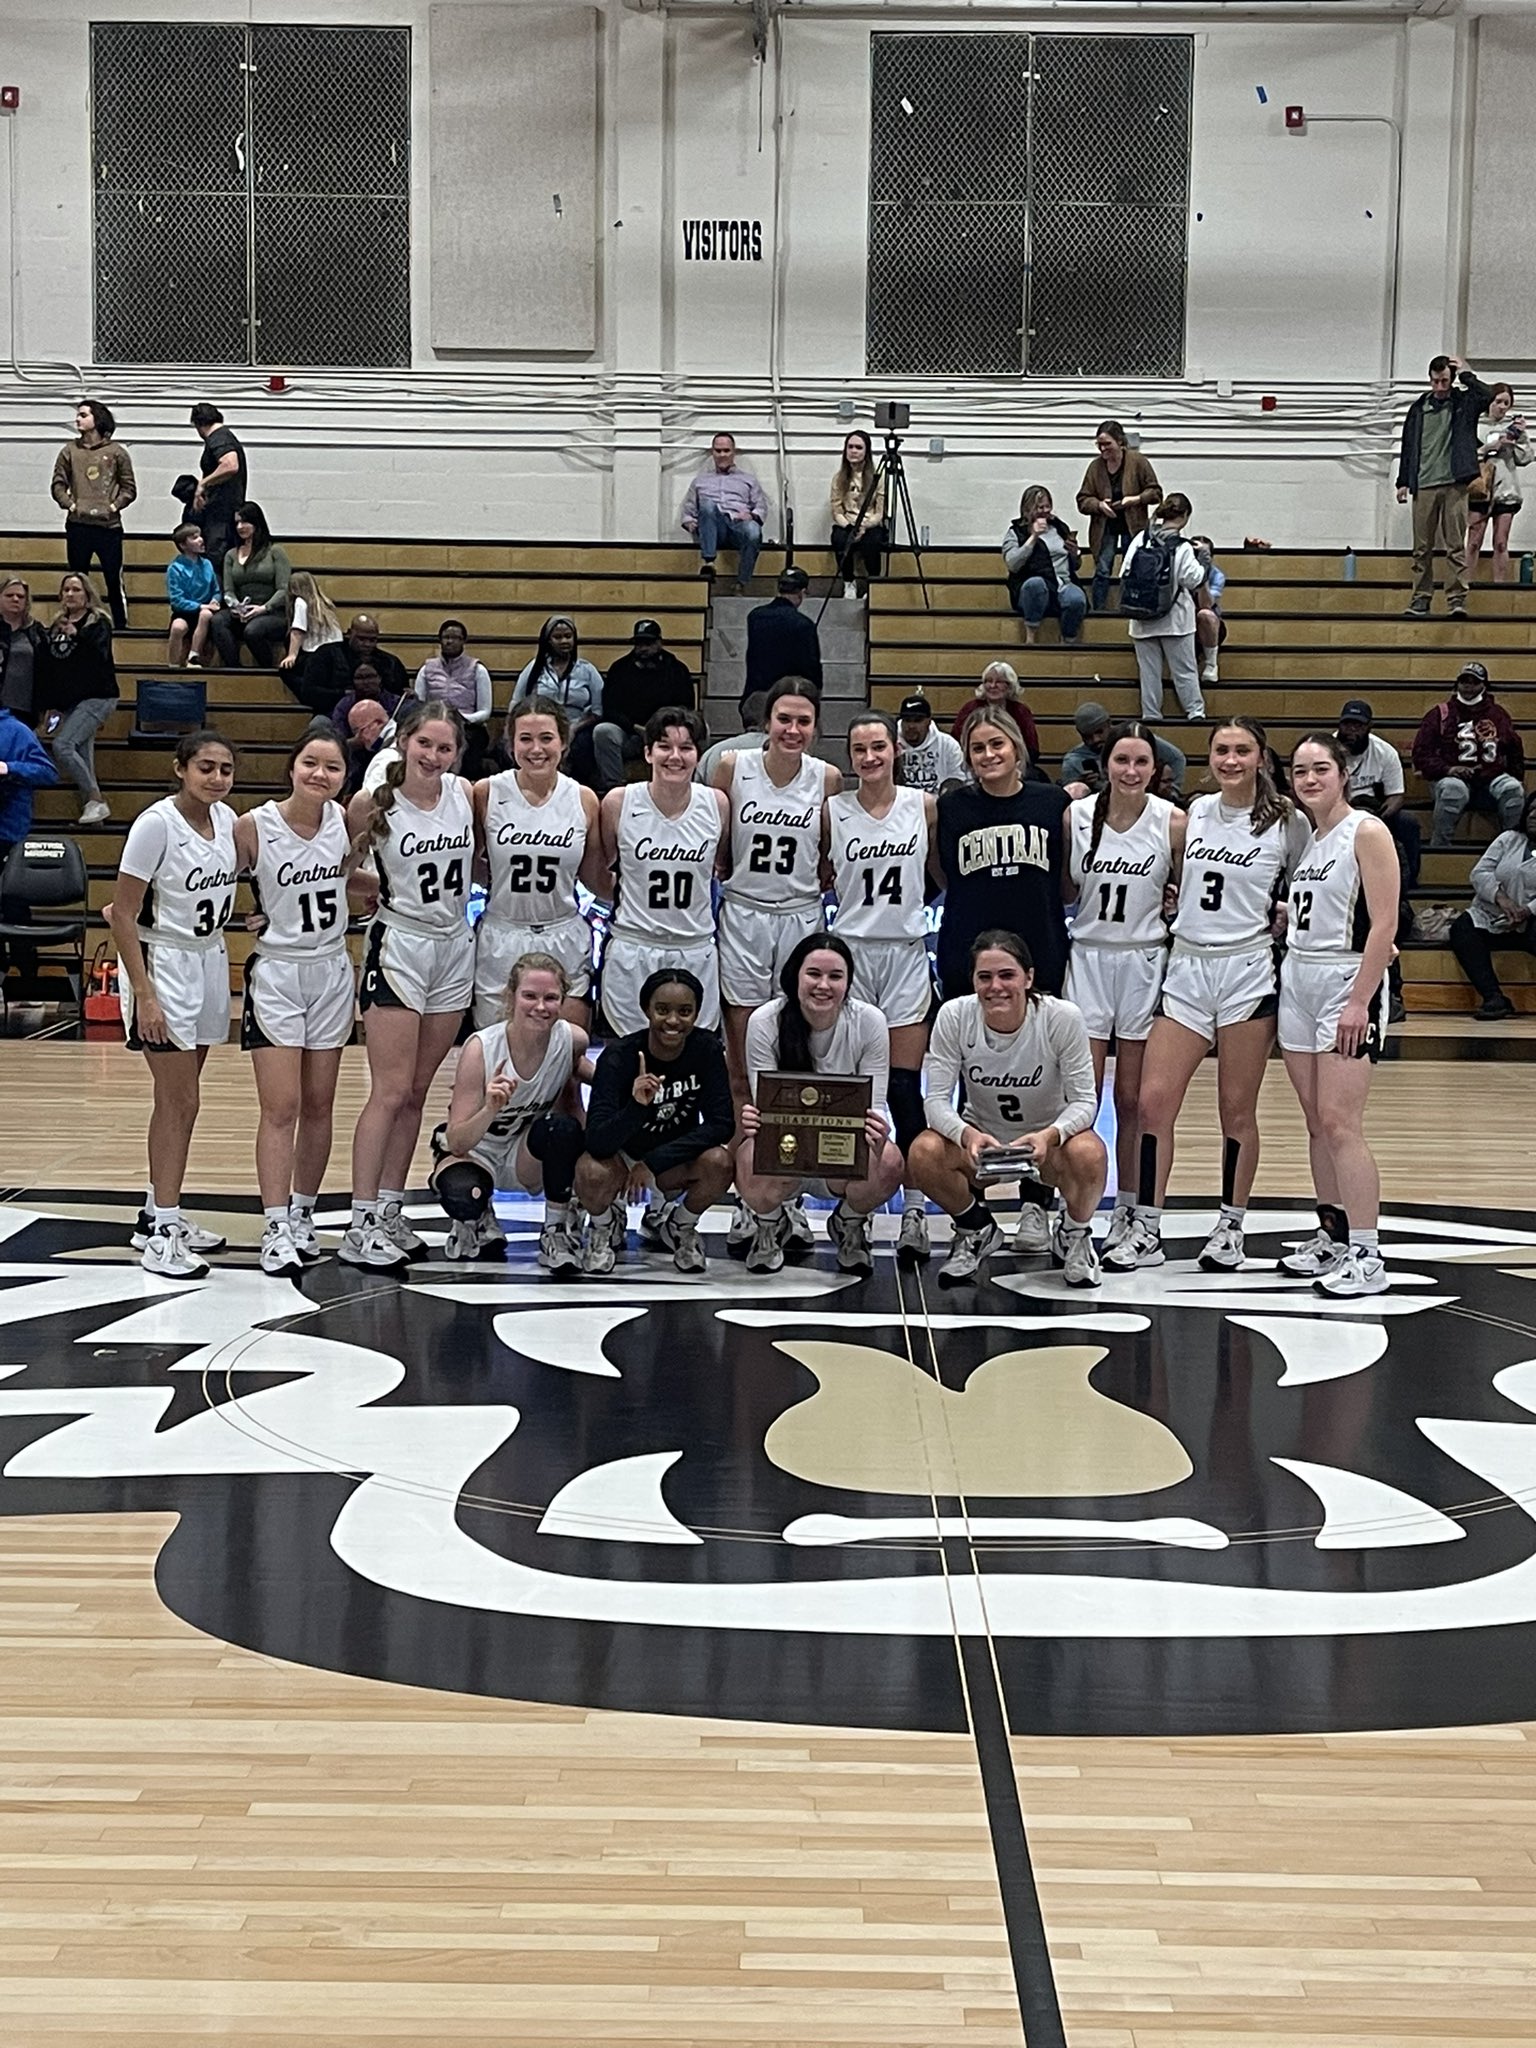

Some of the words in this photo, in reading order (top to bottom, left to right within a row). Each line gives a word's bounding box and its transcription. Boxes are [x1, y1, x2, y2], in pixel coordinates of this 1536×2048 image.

[682, 219, 762, 261] VISITORS
[1458, 741, 1497, 762] 23
[740, 801, 814, 829] Central
[400, 825, 471, 857] Central
[497, 823, 574, 848] Central
[635, 837, 709, 863] Central
[846, 834, 918, 862] Central
[958, 824, 1050, 876] CENTRAL
[750, 834, 797, 875] 23
[1082, 854, 1155, 877] Central
[1185, 838, 1261, 868] Central
[185, 866, 237, 892] Centra
[418, 859, 463, 904] 24
[510, 854, 560, 893] 25
[1292, 859, 1336, 882] entral
[648, 870, 693, 909] 20
[862, 866, 902, 906] 14
[1200, 871, 1224, 912] 3
[193, 894, 232, 937] 34
[298, 889, 337, 932] 15
[1098, 883, 1128, 923] 11
[366, 970, 377, 992] C
[1365, 1022, 1377, 1044] C
[653, 1074, 701, 1104] NTRAL
[969, 1065, 1043, 1087] Central
[774, 1113, 852, 1126] CHAMPIONS
[997, 1094, 1024, 1122] 2
